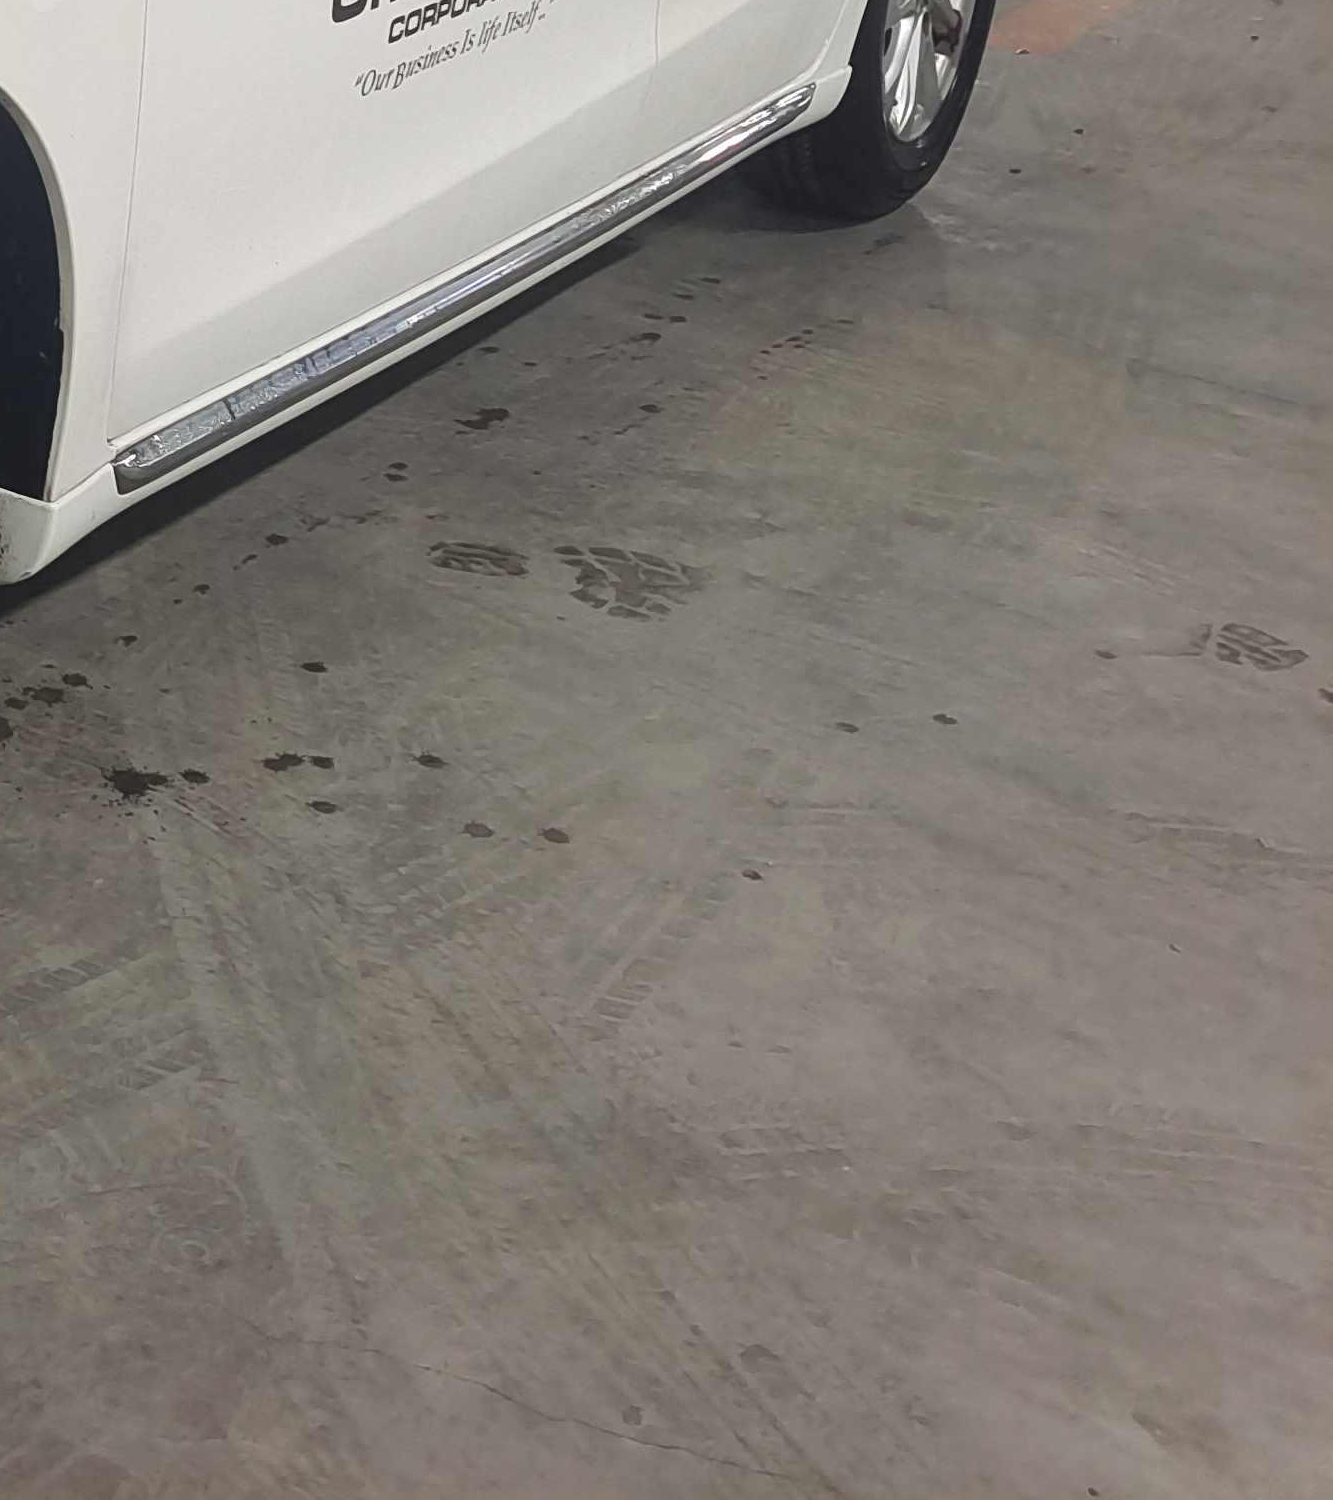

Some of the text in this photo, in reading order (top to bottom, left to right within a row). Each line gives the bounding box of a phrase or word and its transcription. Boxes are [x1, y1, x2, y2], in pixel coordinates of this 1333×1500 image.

[392, 41, 460, 90] Business
[460, 28, 476, 55] Is
[477, 15, 502, 53] life
